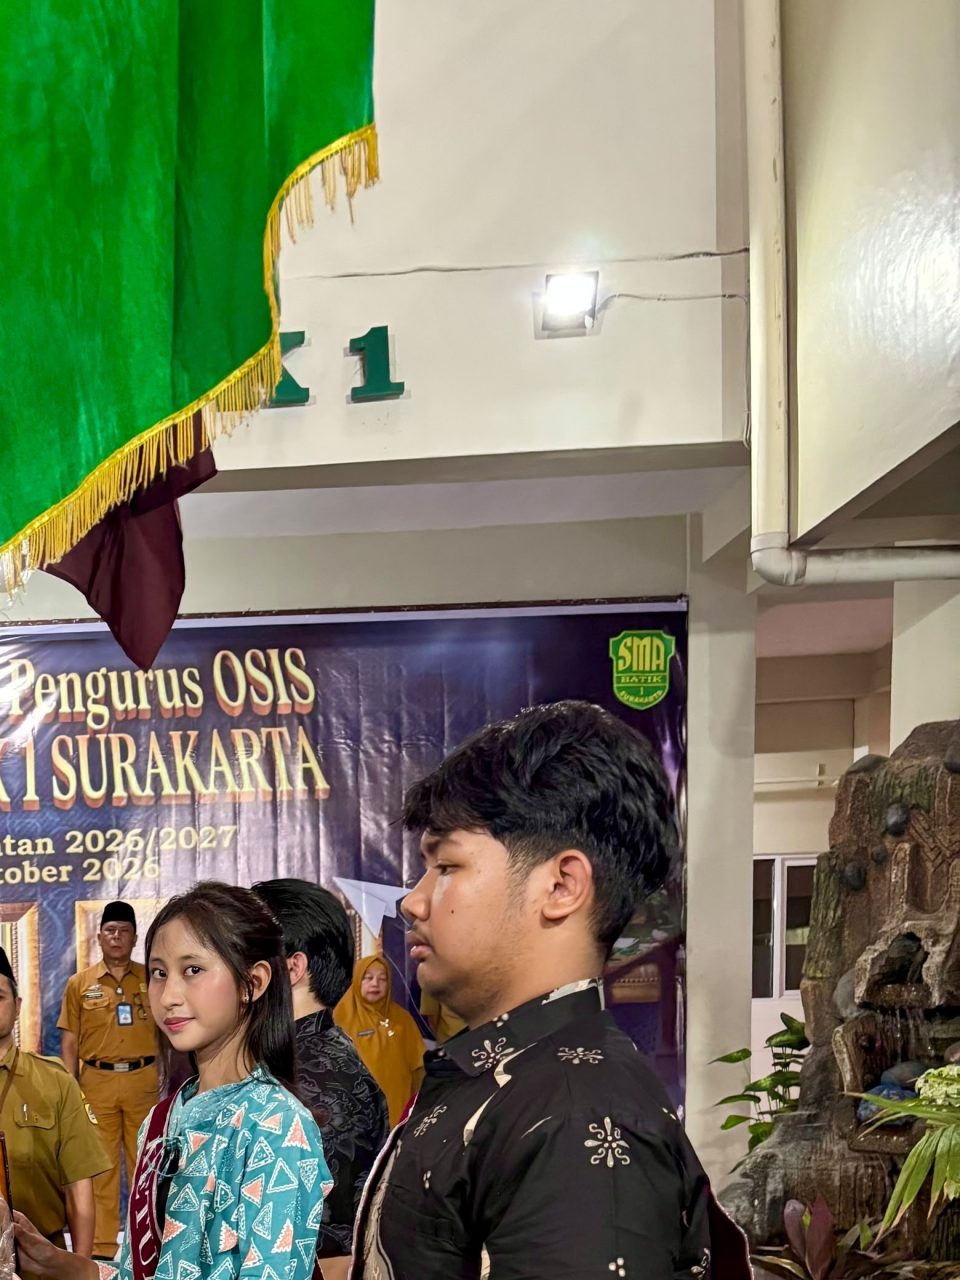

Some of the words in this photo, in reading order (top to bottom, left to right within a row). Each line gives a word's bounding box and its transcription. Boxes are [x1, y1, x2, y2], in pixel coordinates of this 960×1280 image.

[349, 325, 405, 404] 1
[618, 636, 665, 671] SMA
[8, 658, 204, 733] Pengurus
[213, 648, 316, 717] OSIS
[51, 725, 332, 810] SURAKARTA
[65, 825, 238, 857] 2026/2027
[82, 857, 161, 882] 2026
